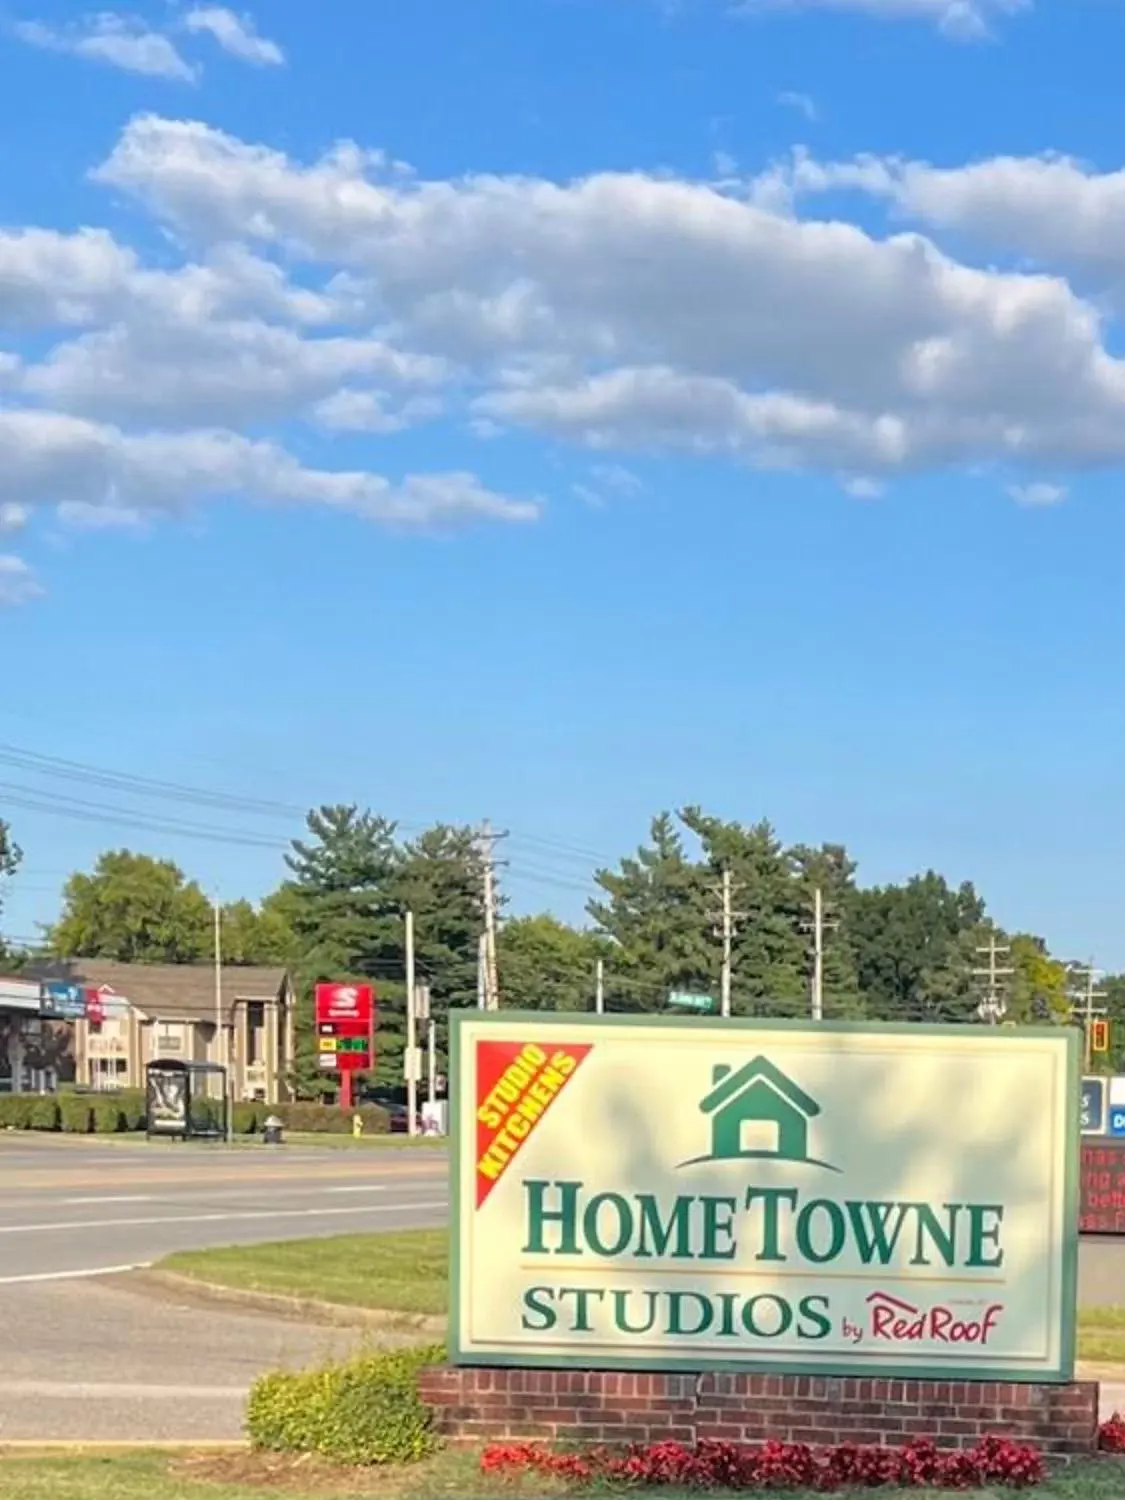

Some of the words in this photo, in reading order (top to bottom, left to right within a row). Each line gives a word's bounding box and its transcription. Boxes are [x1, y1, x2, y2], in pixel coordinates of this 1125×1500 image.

[478, 1043, 547, 1129] STUDIO
[478, 1050, 577, 1180] KITCHENS
[521, 1286, 832, 1340] STUDIOS
[841, 1316, 864, 1344] by
